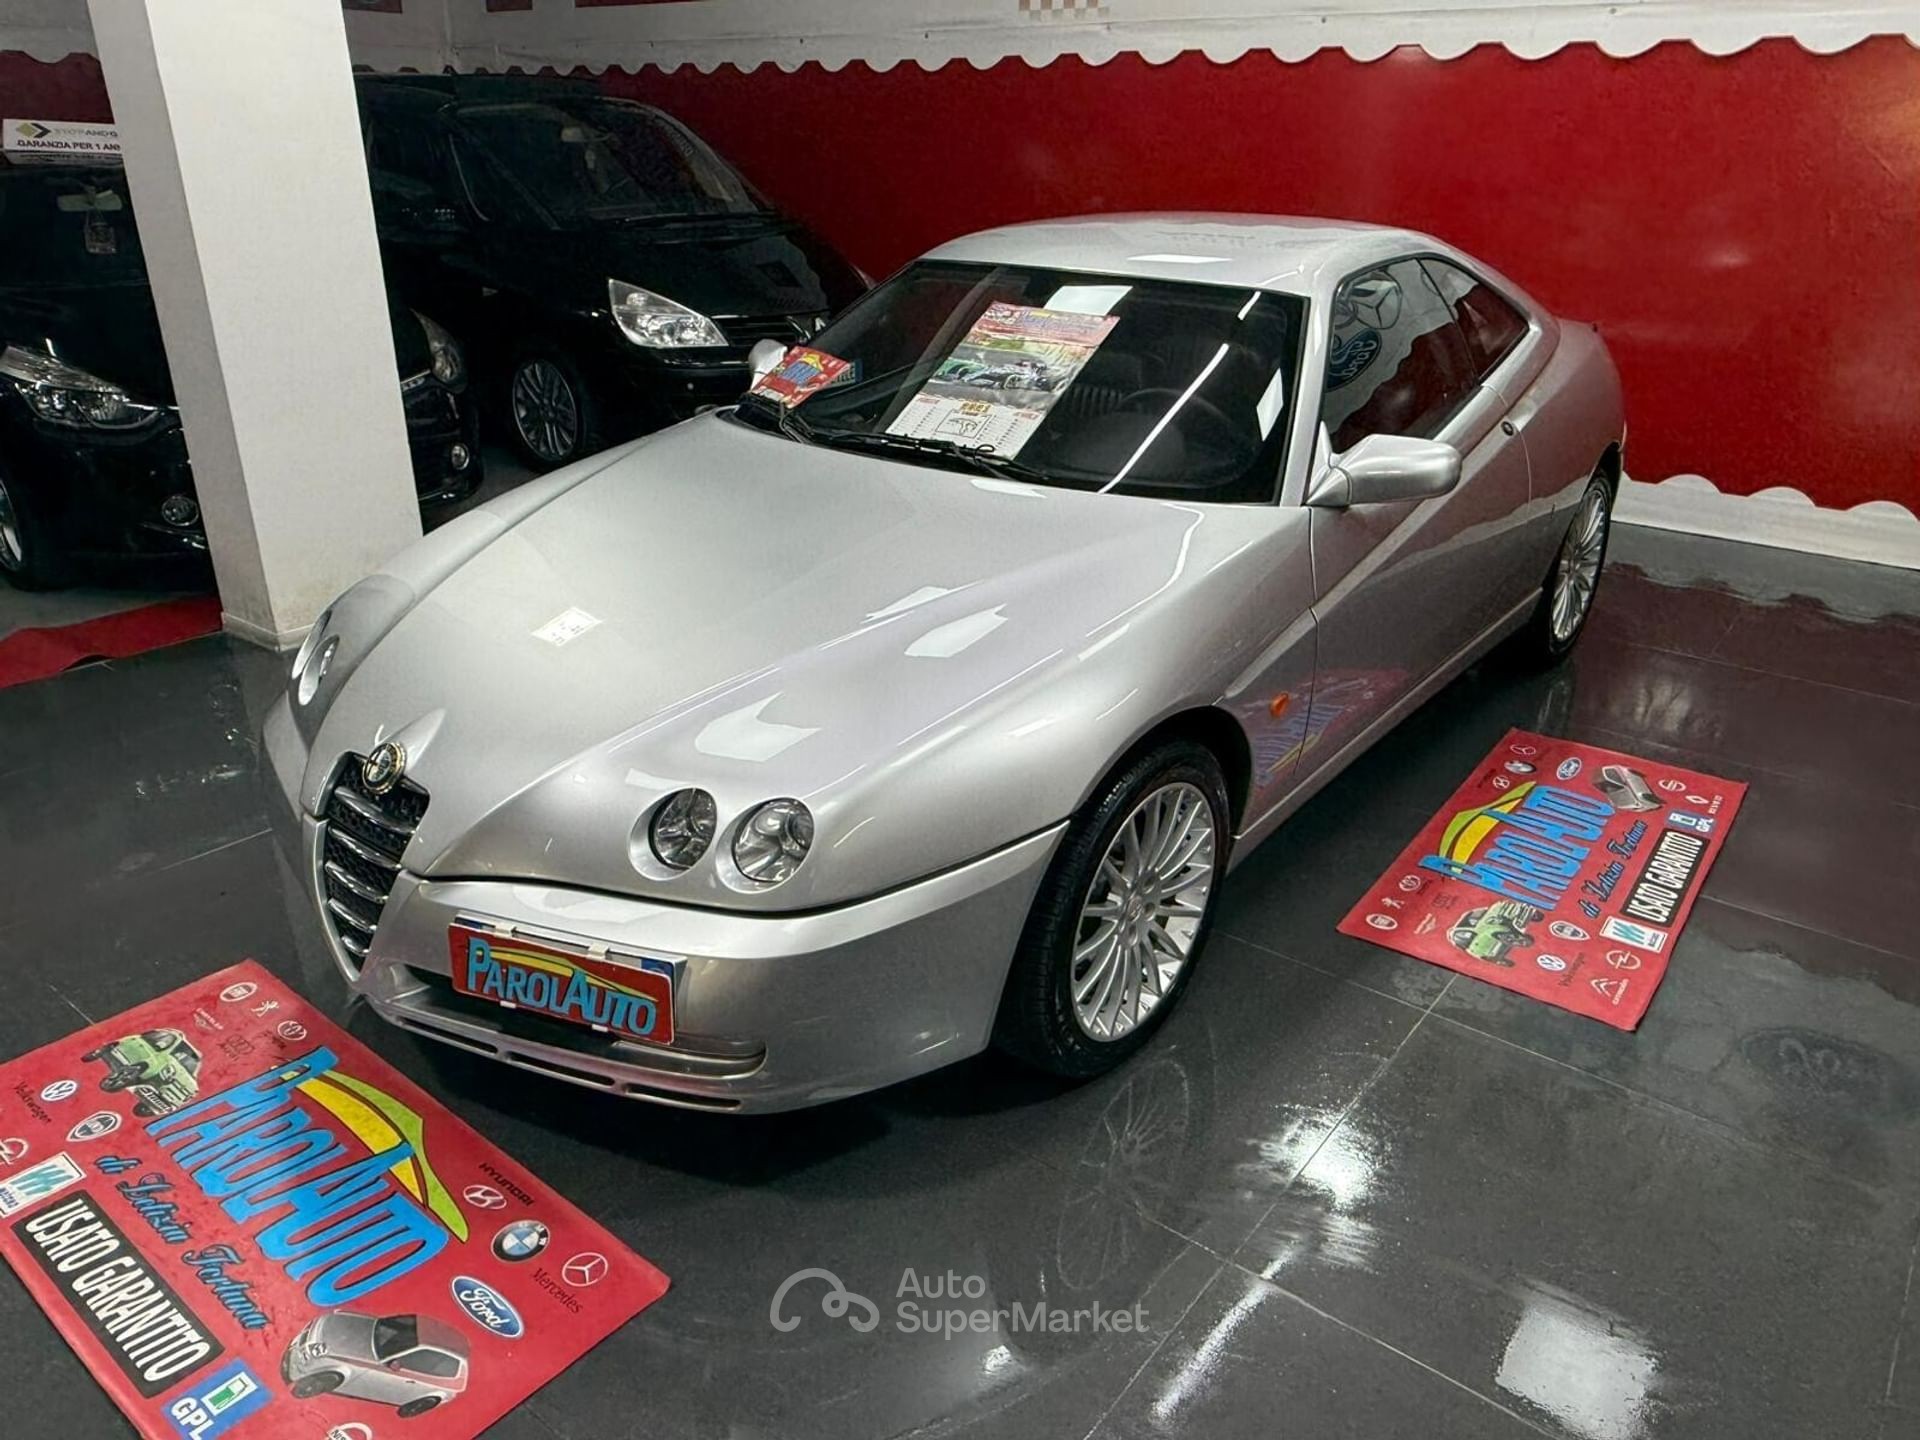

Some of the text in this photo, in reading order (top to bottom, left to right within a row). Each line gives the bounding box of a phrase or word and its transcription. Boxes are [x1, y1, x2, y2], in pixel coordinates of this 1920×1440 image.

[73, 142, 94, 150] PER
[1626, 830, 1704, 923] USATO GARANTITO
[479, 1162, 535, 1208] HYUNDAI
[93, 1155, 142, 1175] di
[181, 1243, 270, 1331] Fortuna
[25, 1198, 211, 1382] USATO GARANTITO
[459, 1287, 512, 1329] Ford
[532, 1267, 584, 1315] Mercedes
[170, 1396, 216, 1440] GPL
